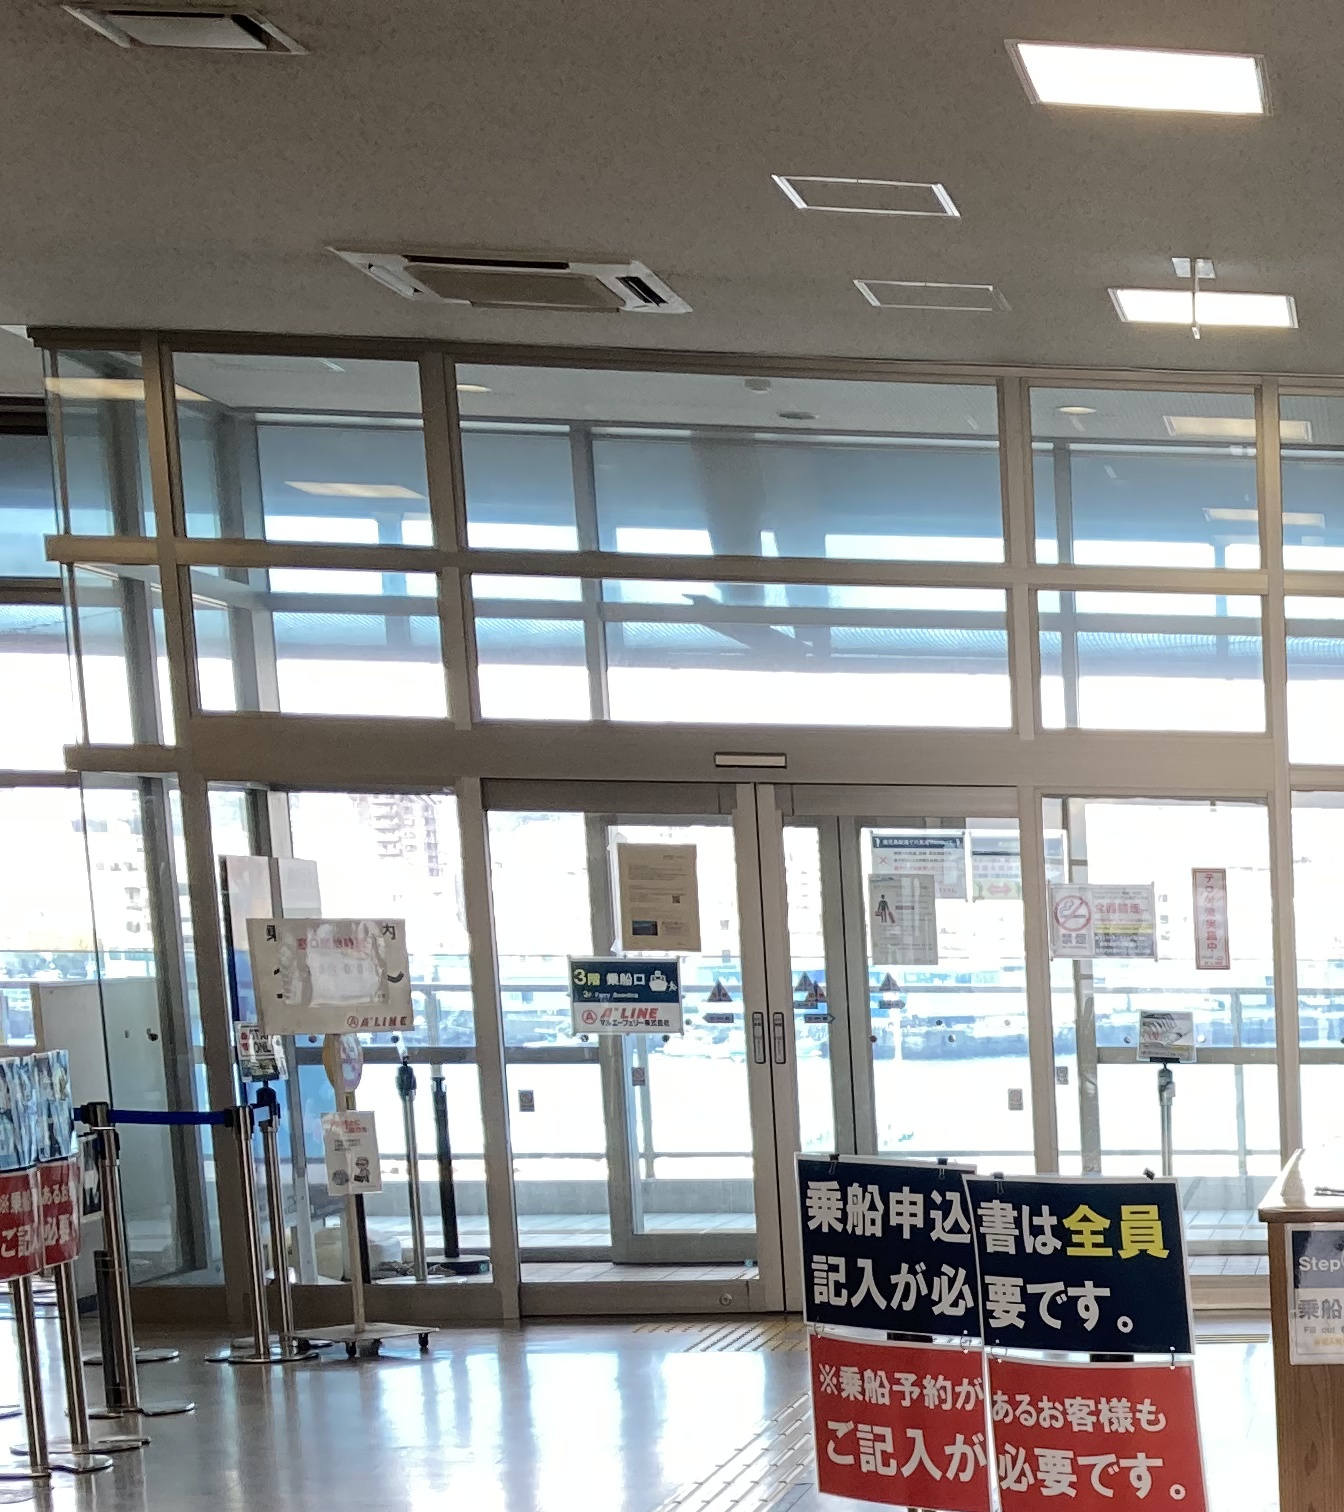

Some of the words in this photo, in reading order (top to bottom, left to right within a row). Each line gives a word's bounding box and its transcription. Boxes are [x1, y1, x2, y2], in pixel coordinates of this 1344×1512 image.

[805, 1180, 1170, 1260] 乗船申込書は全員
[811, 1255, 1134, 1334] 記入が必要です。
[818, 1363, 1167, 1434] ※乗船予約があるお客様も
[825, 1420, 1187, 1500] ご記入が必要です。
